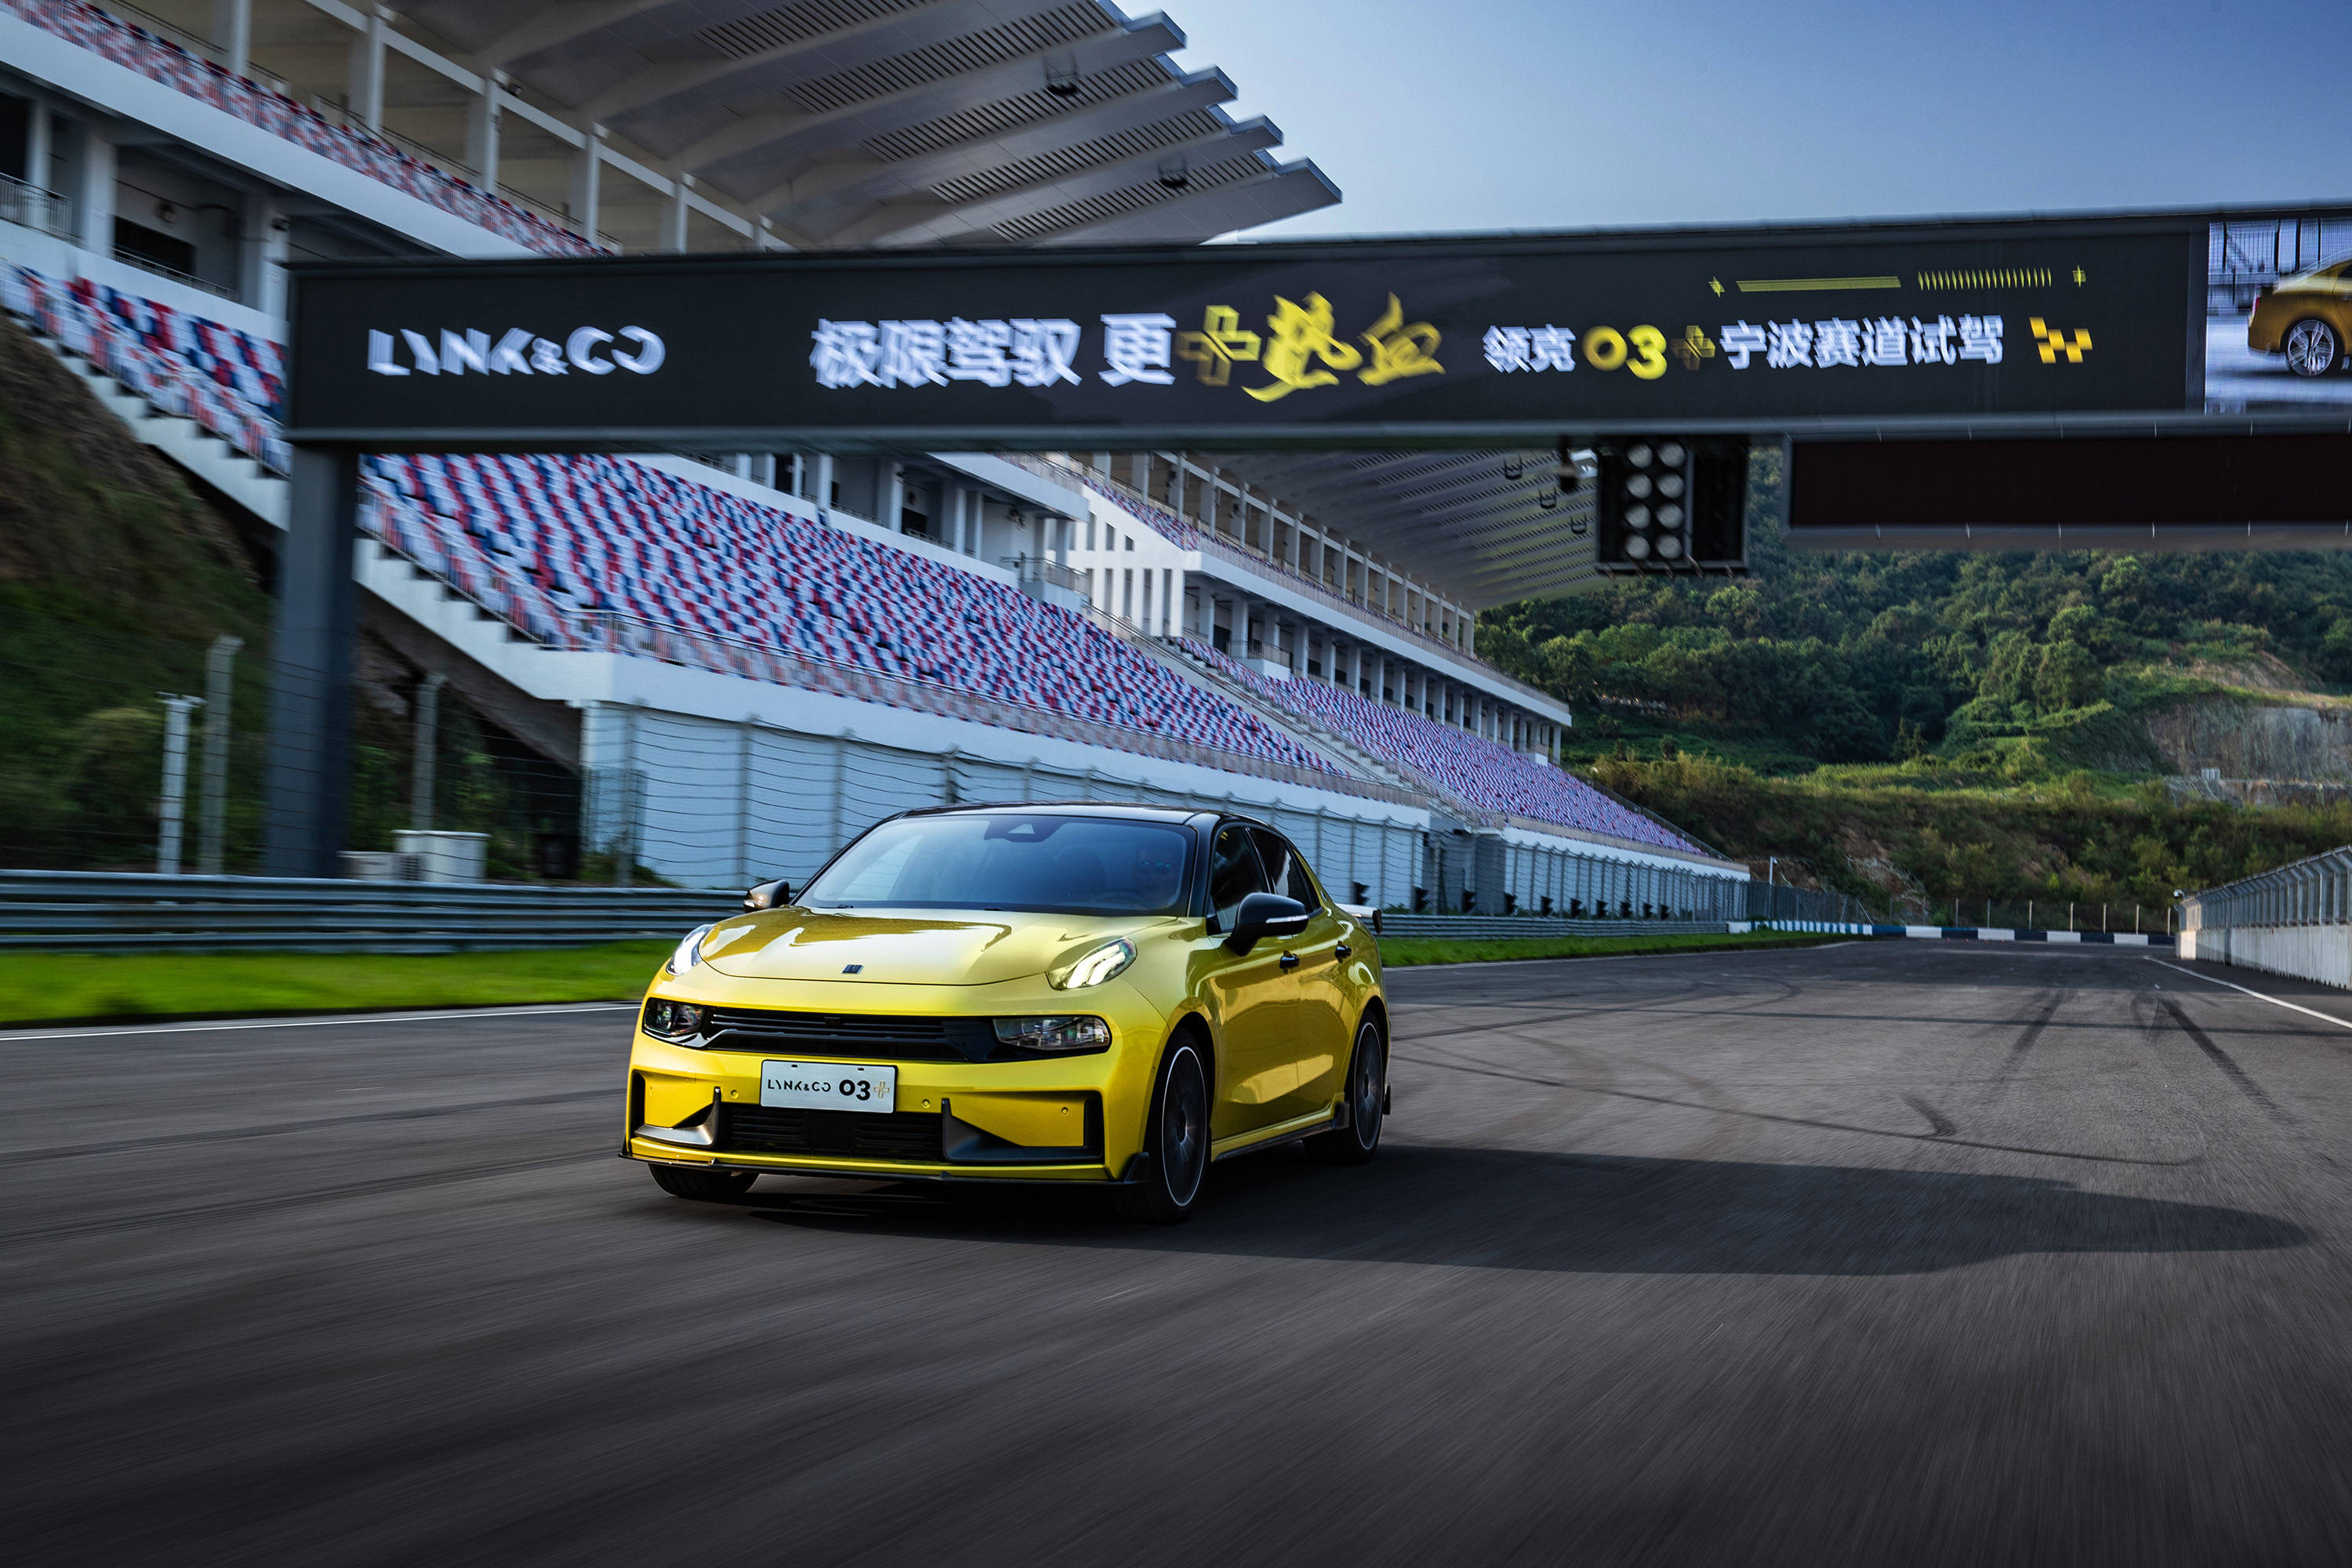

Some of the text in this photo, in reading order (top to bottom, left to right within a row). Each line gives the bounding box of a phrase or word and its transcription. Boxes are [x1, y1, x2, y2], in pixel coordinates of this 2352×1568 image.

[367, 325, 666, 376] LYNK&CO
[809, 317, 1083, 389] 极限驾驭
[768, 1079, 831, 1092] LYNK&CO
